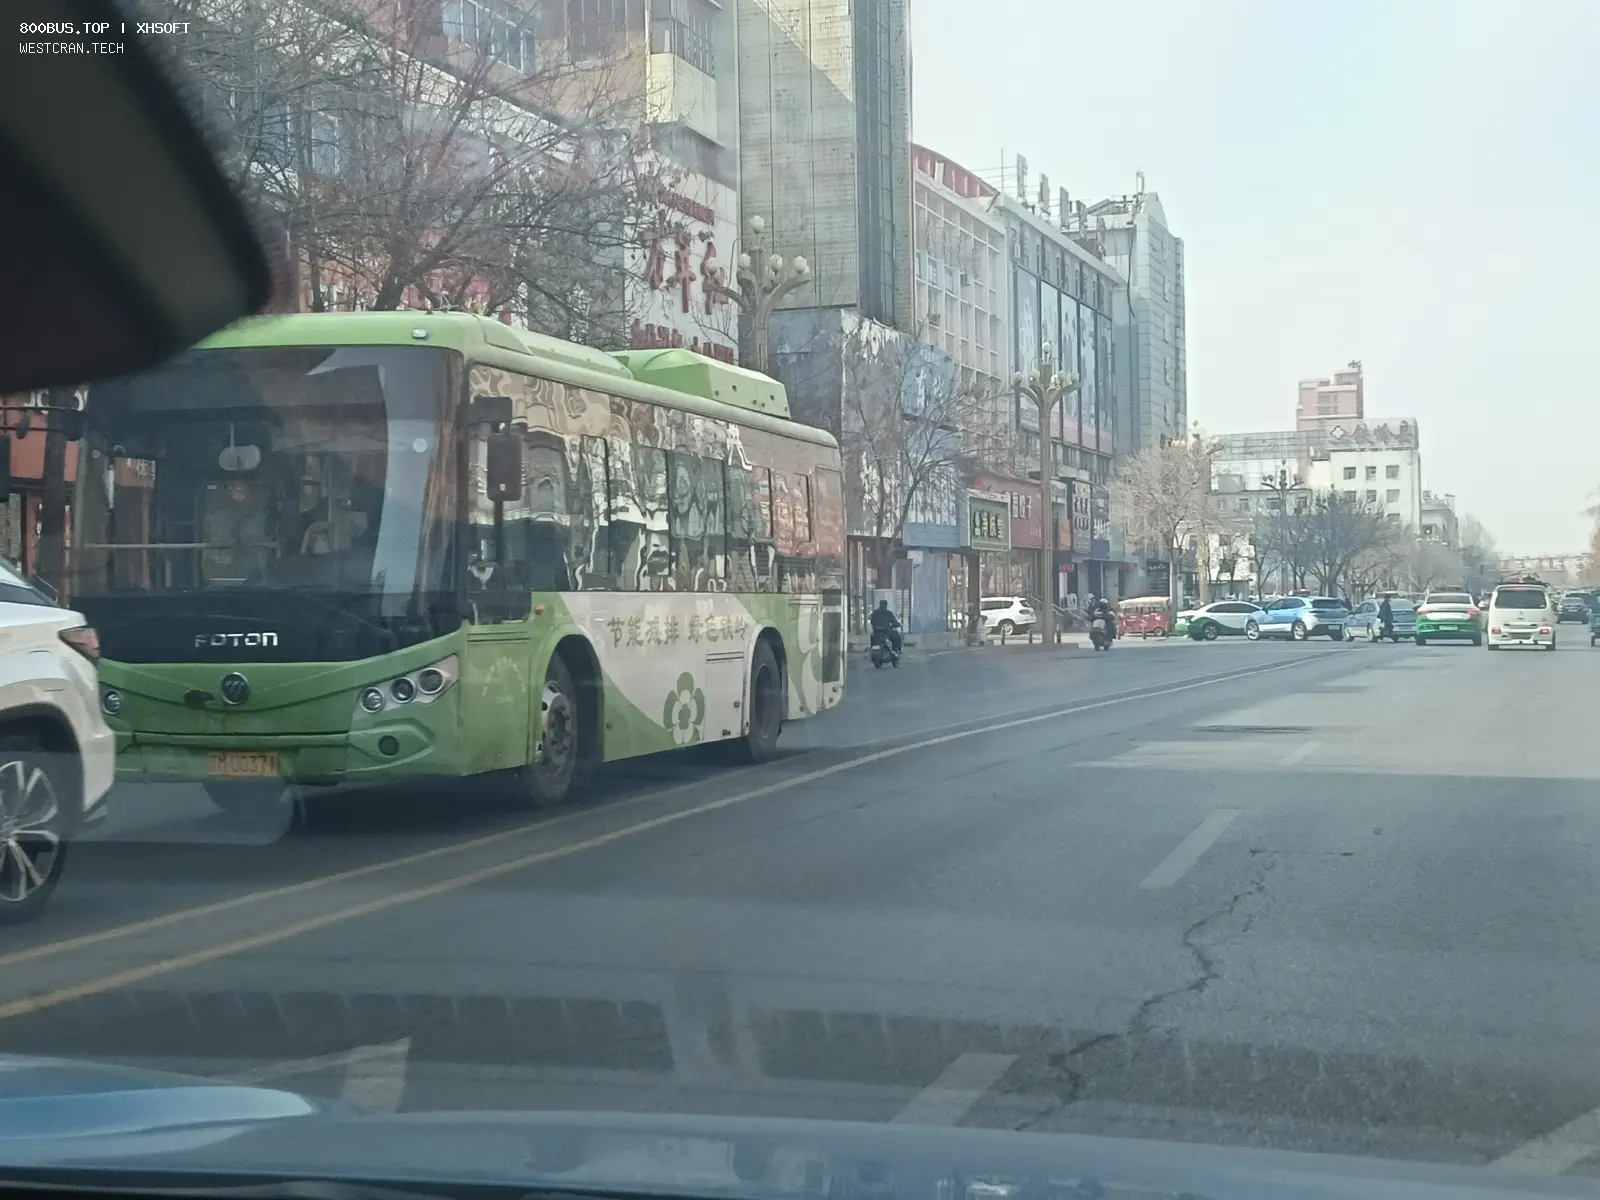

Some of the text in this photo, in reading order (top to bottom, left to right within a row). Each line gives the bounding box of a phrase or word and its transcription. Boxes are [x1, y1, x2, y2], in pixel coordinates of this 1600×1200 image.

[194, 632, 278, 647] FOTON
[607, 614, 680, 648] 节能减排
